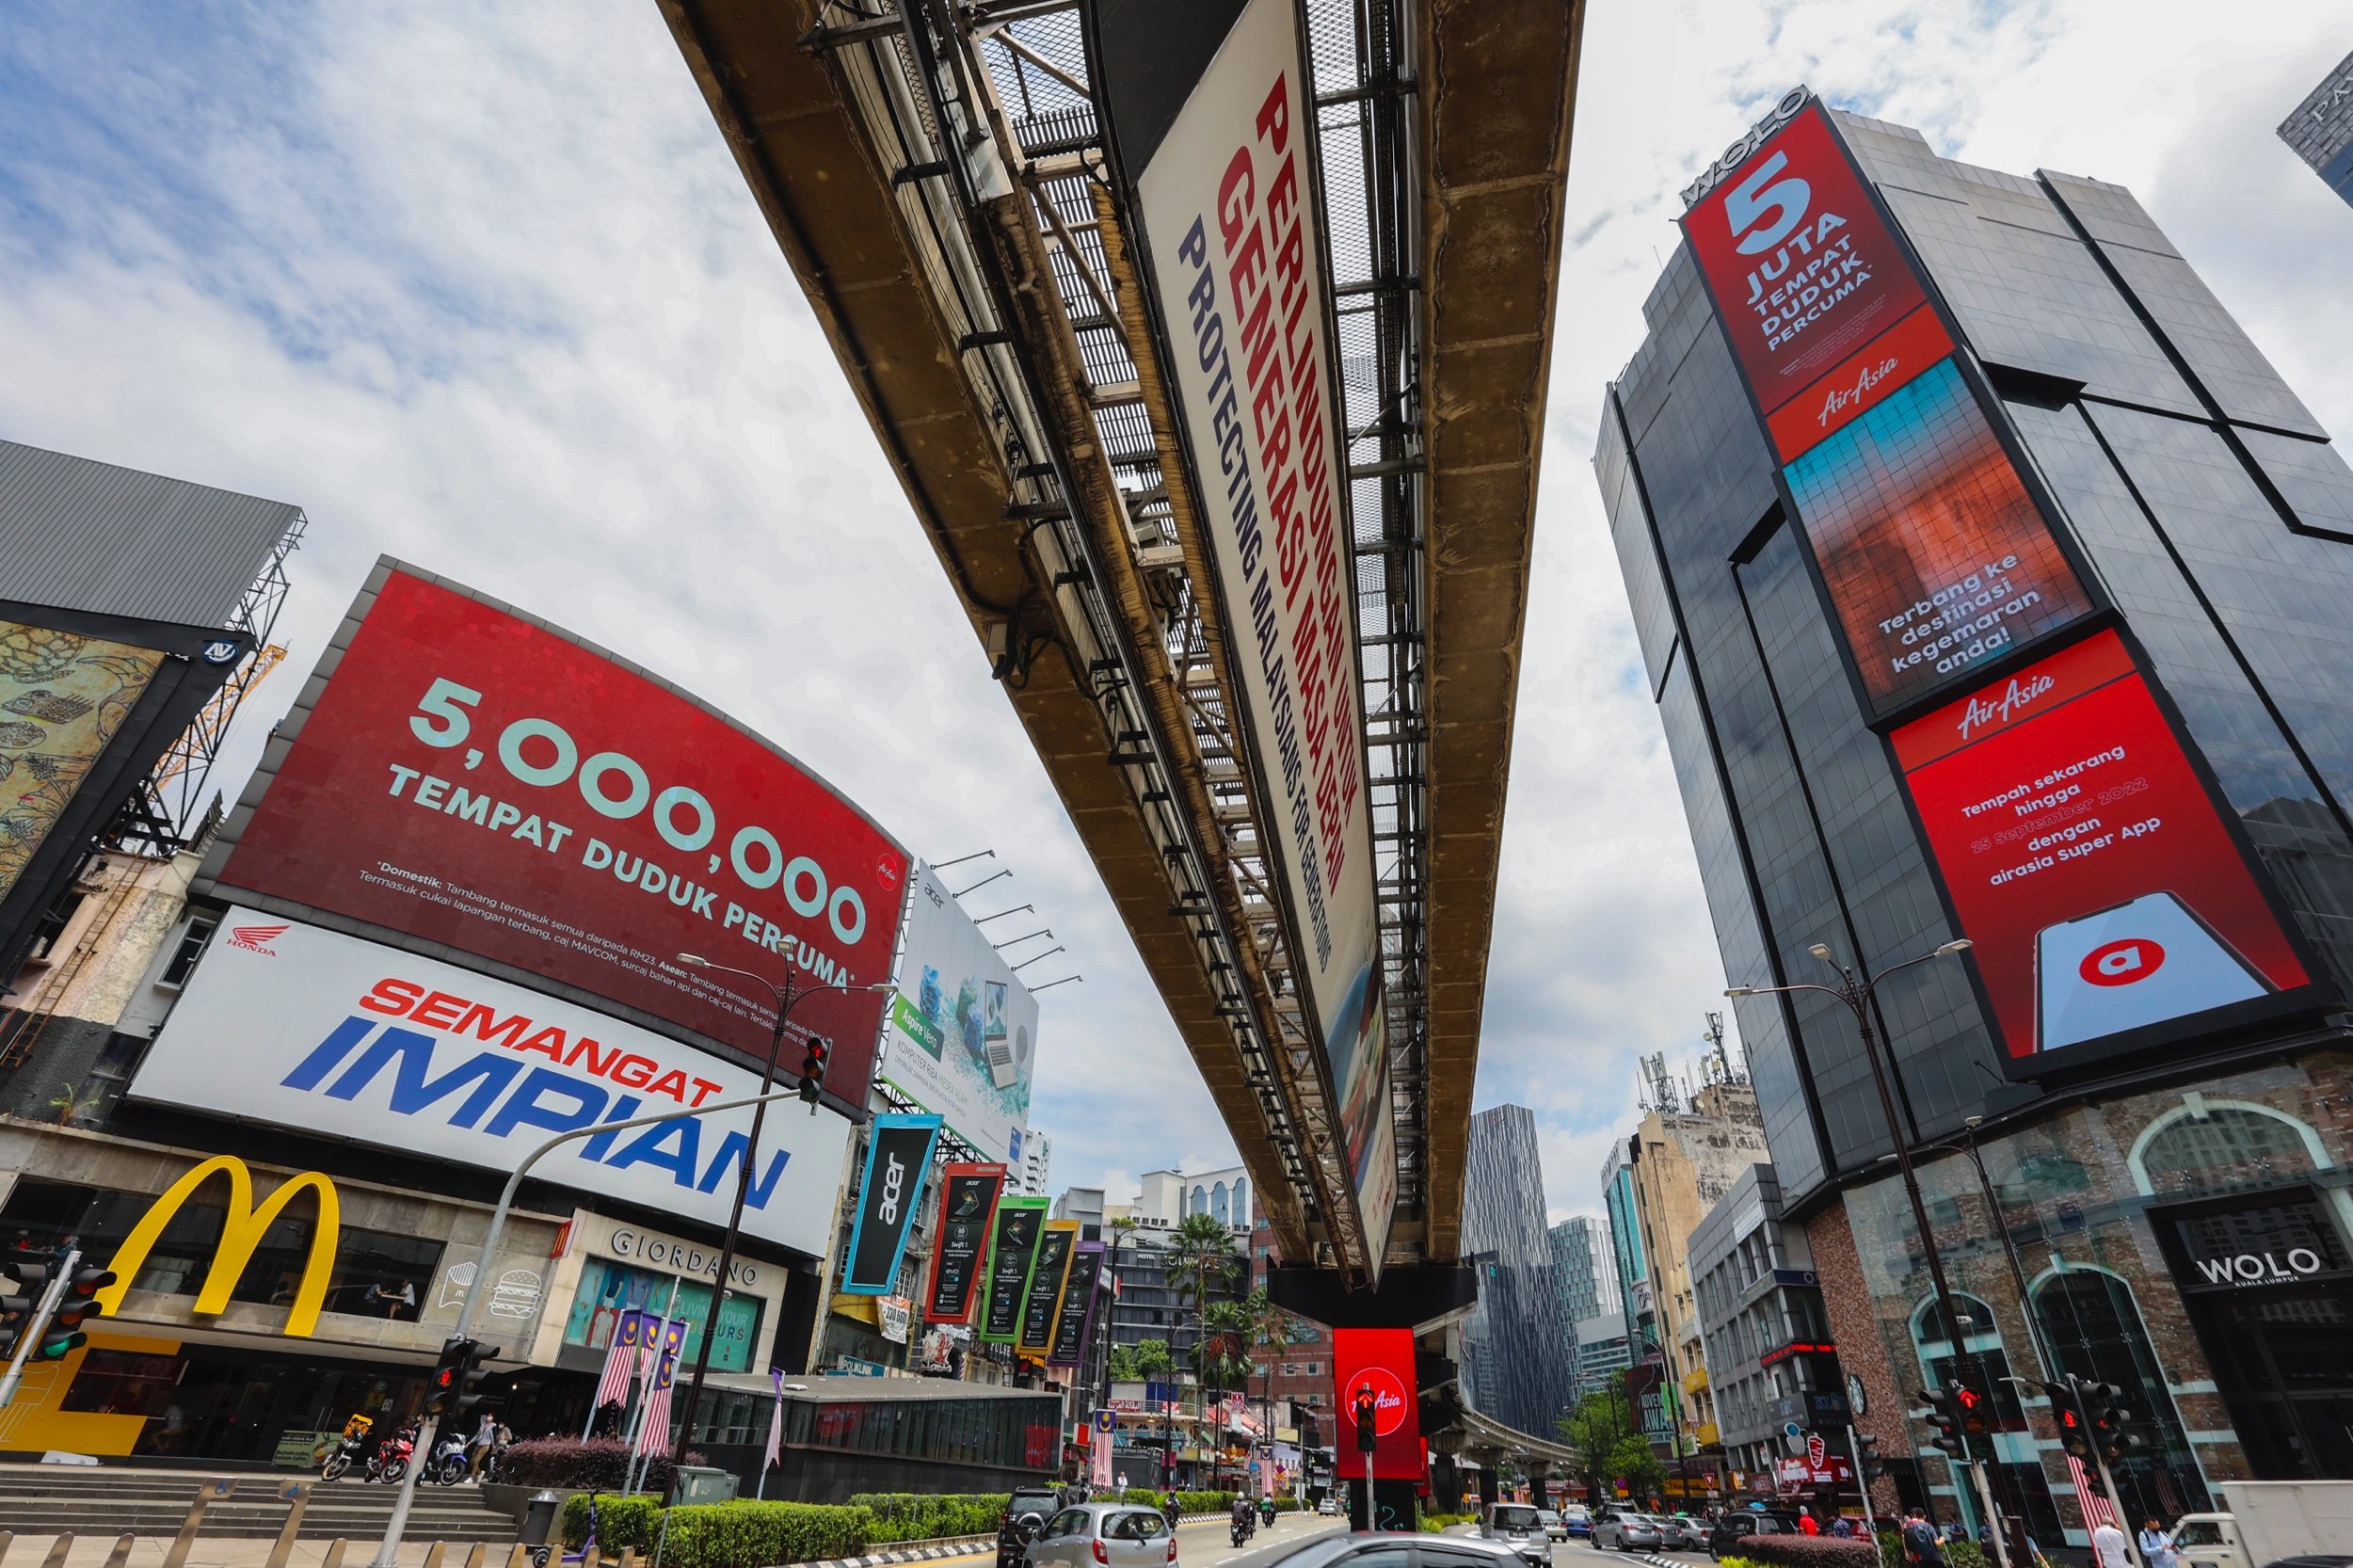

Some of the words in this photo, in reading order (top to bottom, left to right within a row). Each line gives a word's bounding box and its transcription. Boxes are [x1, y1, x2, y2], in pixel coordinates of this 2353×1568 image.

[2313, 76, 2353, 121] PA
[1679, 86, 1809, 201] WOLO
[1723, 150, 1811, 255] 5
[1746, 212, 1848, 306] JUTA
[1754, 233, 1851, 316] TEMPAT
[1760, 250, 1864, 337] DUDUK
[1817, 356, 1898, 426] AirAsia
[1256, 69, 1345, 686] PERLINDUNGAN
[1333, 665, 1357, 830] UNTUK
[1217, 145, 1308, 615] GENERASI
[1292, 589, 1329, 778] MASA
[1316, 747, 1346, 898] DEPAN
[1178, 213, 1262, 584] PROTECTING
[1250, 567, 1302, 799] MALAYSIANS
[1291, 781, 1311, 851] FOR
[1302, 835, 1332, 974] GENERATIONS
[1879, 575, 1981, 634] Terbang
[1984, 554, 2018, 579] ke
[1900, 577, 2013, 646] destinasi
[1891, 589, 2041, 674] kegemaran
[1936, 626, 2012, 674] anda!
[1957, 675, 2055, 740] AirAsia
[408, 677, 867, 945] 5,000,000
[1961, 784, 2031, 818] Tempah
[2034, 745, 2126, 789] sekarang
[1971, 840, 1992, 854] 25
[1995, 798, 2094, 844] September
[2097, 776, 2149, 805] 2022
[2014, 783, 2082, 817] hingga
[387, 763, 573, 856] TEMPAT
[581, 838, 718, 921] DUDUK
[1990, 854, 2055, 886] airasia
[2057, 831, 2114, 861] Super
[2121, 815, 2162, 840] App
[2027, 817, 2102, 852] dengan
[924, 882, 944, 909] acer
[226, 938, 277, 957] HONDA
[359, 870, 417, 896] Termasuk
[420, 889, 452, 906] cukai
[453, 899, 505, 924] lapangan
[507, 917, 552, 941] terbang,
[553, 935, 569, 948] caj
[571, 939, 619, 965] MAVCOM,
[620, 958, 648, 977] surcaj
[648, 968, 676, 985] bahan
[677, 981, 691, 994] api
[692, 985, 707, 1000] dan
[708, 994, 733, 1014] caj-caj
[733, 1003, 747, 1017] lain.
[749, 1012, 778, 1032] Tertaklu
[780, 1029, 798, 1043] erma
[446, 882, 497, 909] Tambang
[500, 901, 549, 925] termasuk
[551, 919, 584, 937] semua
[586, 931, 629, 954] daripada
[658, 960, 688, 978] Asean:
[689, 972, 725, 997] Tambang
[726, 988, 759, 1010] termasuk
[759, 1005, 781, 1021] semu
[781, 1017, 809, 1036] aripada
[360, 977, 723, 1109] SEMANGAT
[897, 1038, 927, 1072] KOMPUTER
[926, 1064, 938, 1080] RIBA
[902, 1007, 923, 1036] Aspire
[923, 1025, 937, 1048] Vero
[280, 1015, 792, 1211] IMPIAN
[878, 1151, 905, 1224] acer
[612, 1228, 759, 1286] GIORDANO
[951, 1241, 965, 1250] Swift
[2196, 1248, 2320, 1284] WOLO
[2265, 1276, 2300, 1285] LUMPUR
[680, 1303, 714, 1320] LIVIN
[720, 1309, 747, 1326] YOUR
[990, 1341, 1011, 1356] PULSE
[1641, 1393, 1664, 1409] ADVEN
[1644, 1409, 1674, 1431] AWA
